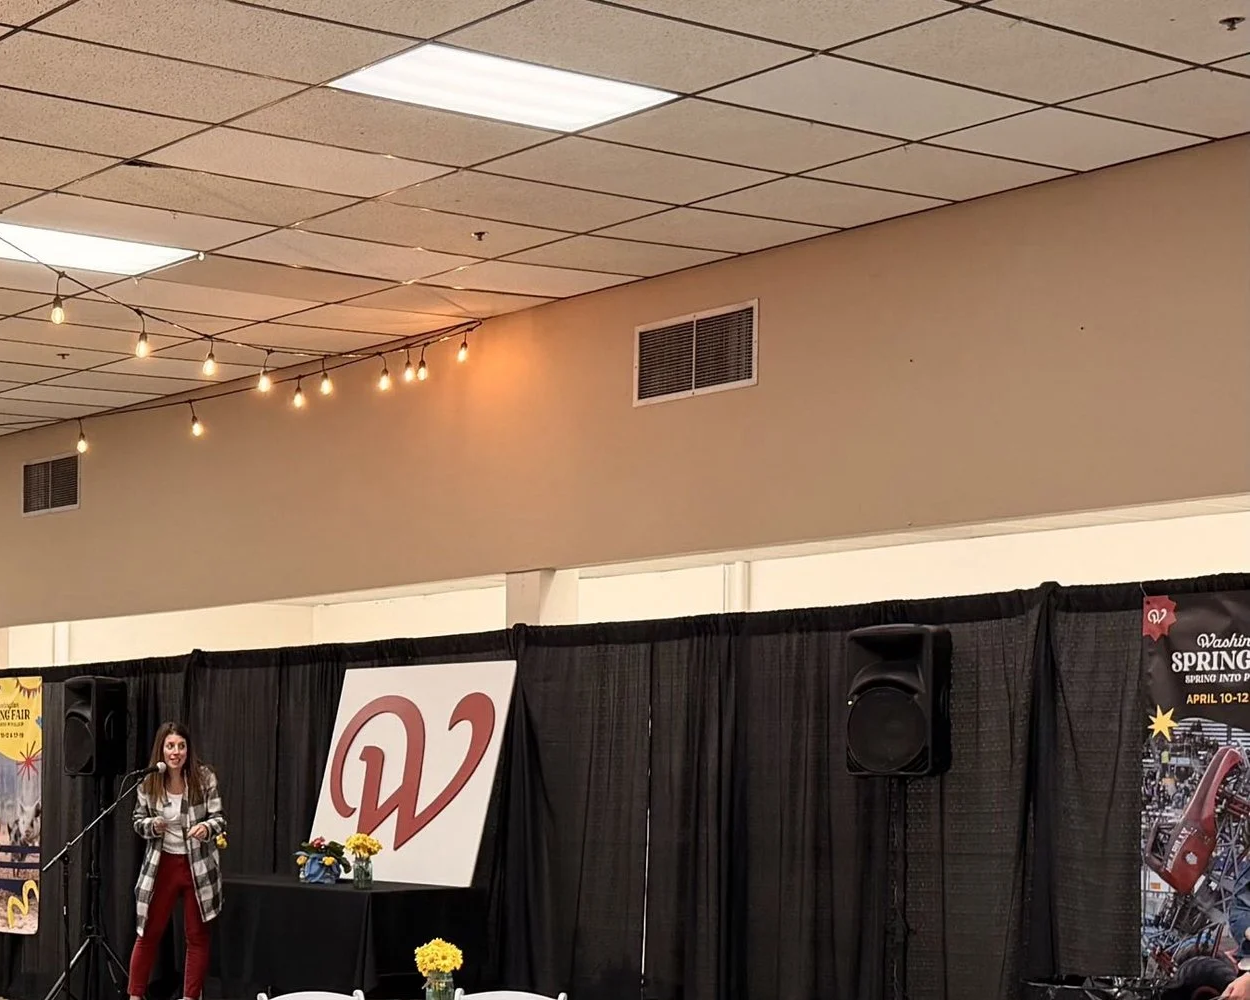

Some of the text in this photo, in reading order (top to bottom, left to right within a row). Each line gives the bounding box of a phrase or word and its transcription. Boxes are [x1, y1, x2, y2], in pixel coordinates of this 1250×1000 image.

[1171, 649, 1250, 673] SPRING
[1185, 674, 1216, 684] SPRING
[1219, 673, 1241, 683] INTO
[1186, 692, 1249, 705] APRIL 10-12
[11, 708, 31, 720] FAIR
